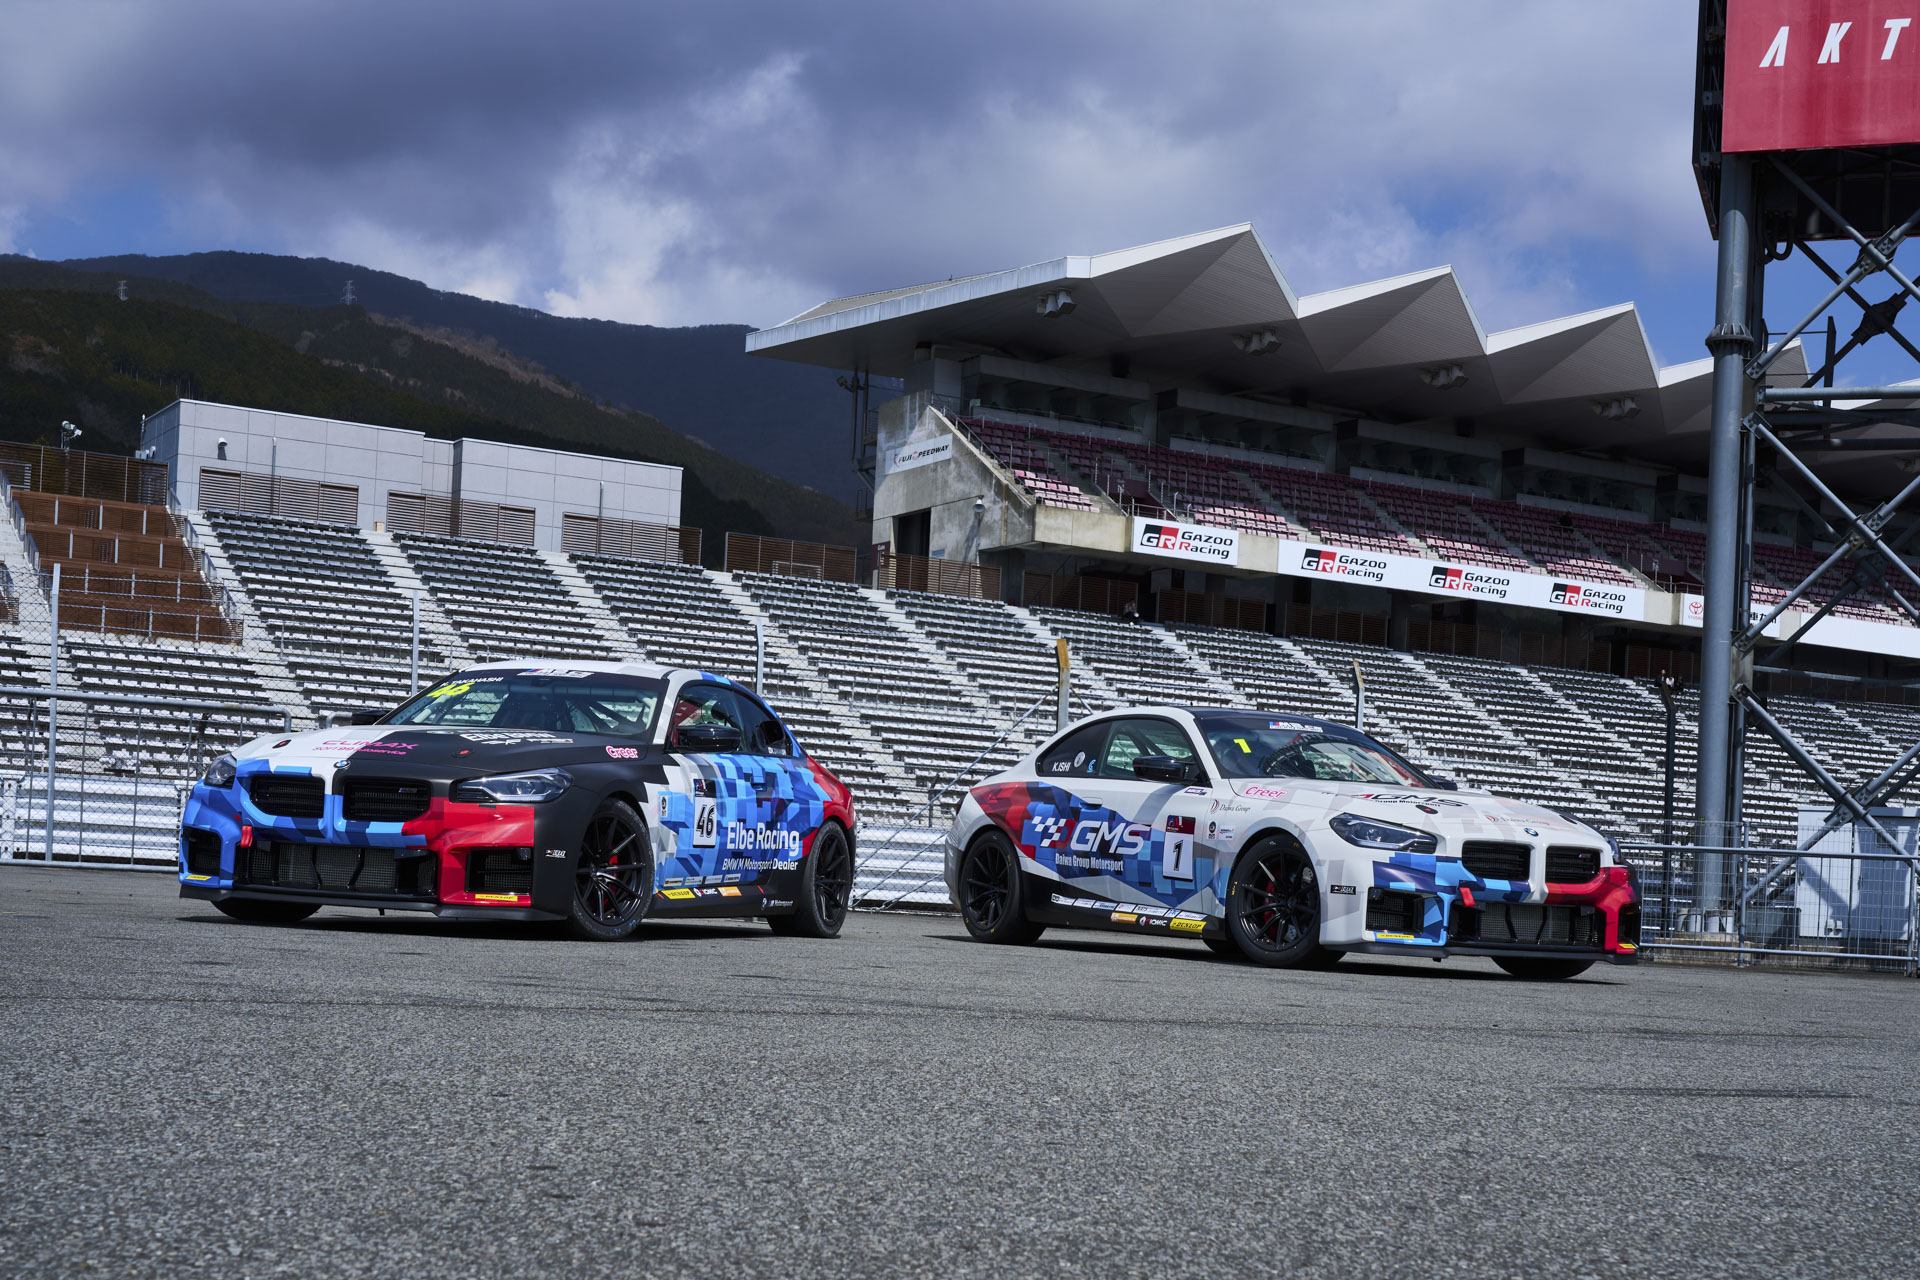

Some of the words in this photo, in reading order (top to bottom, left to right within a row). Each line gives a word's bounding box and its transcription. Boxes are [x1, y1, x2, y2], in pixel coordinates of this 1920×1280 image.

[1141, 532, 1176, 549] GR
[1181, 531, 1234, 547] GAZOO
[1178, 541, 1230, 560] Racing
[1302, 557, 1334, 573] GR
[1338, 555, 1388, 570] GAZOO
[1336, 565, 1384, 582] Racing
[1464, 572, 1511, 587] GAZOO
[1430, 574, 1460, 590] GR
[1462, 581, 1507, 598] Racing
[1550, 590, 1579, 606] GR
[1583, 588, 1626, 602] GAZOO
[1580, 598, 1623, 614] Racing
[426, 682, 475, 698] 46
[322, 740, 420, 750] CLIMAX
[605, 745, 639, 759] Creer
[1233, 738, 1252, 754] 1
[1245, 786, 1287, 798] Creer
[1371, 793, 1470, 808] GMS
[695, 804, 716, 838] 46
[726, 821, 755, 850] Elbe
[755, 822, 800, 857] Racing
[1070, 820, 1151, 855] GMS
[1055, 853, 1073, 867] Daiwa
[1072, 855, 1090, 871] Group
[1090, 857, 1124, 872] Motorsport
[1172, 839, 1184, 872] 1
[722, 858, 738, 871] BMW
[744, 858, 773, 872] Motorsport
[772, 858, 799, 871] Dealer
[1176, 921, 1203, 929] DUNLOP
